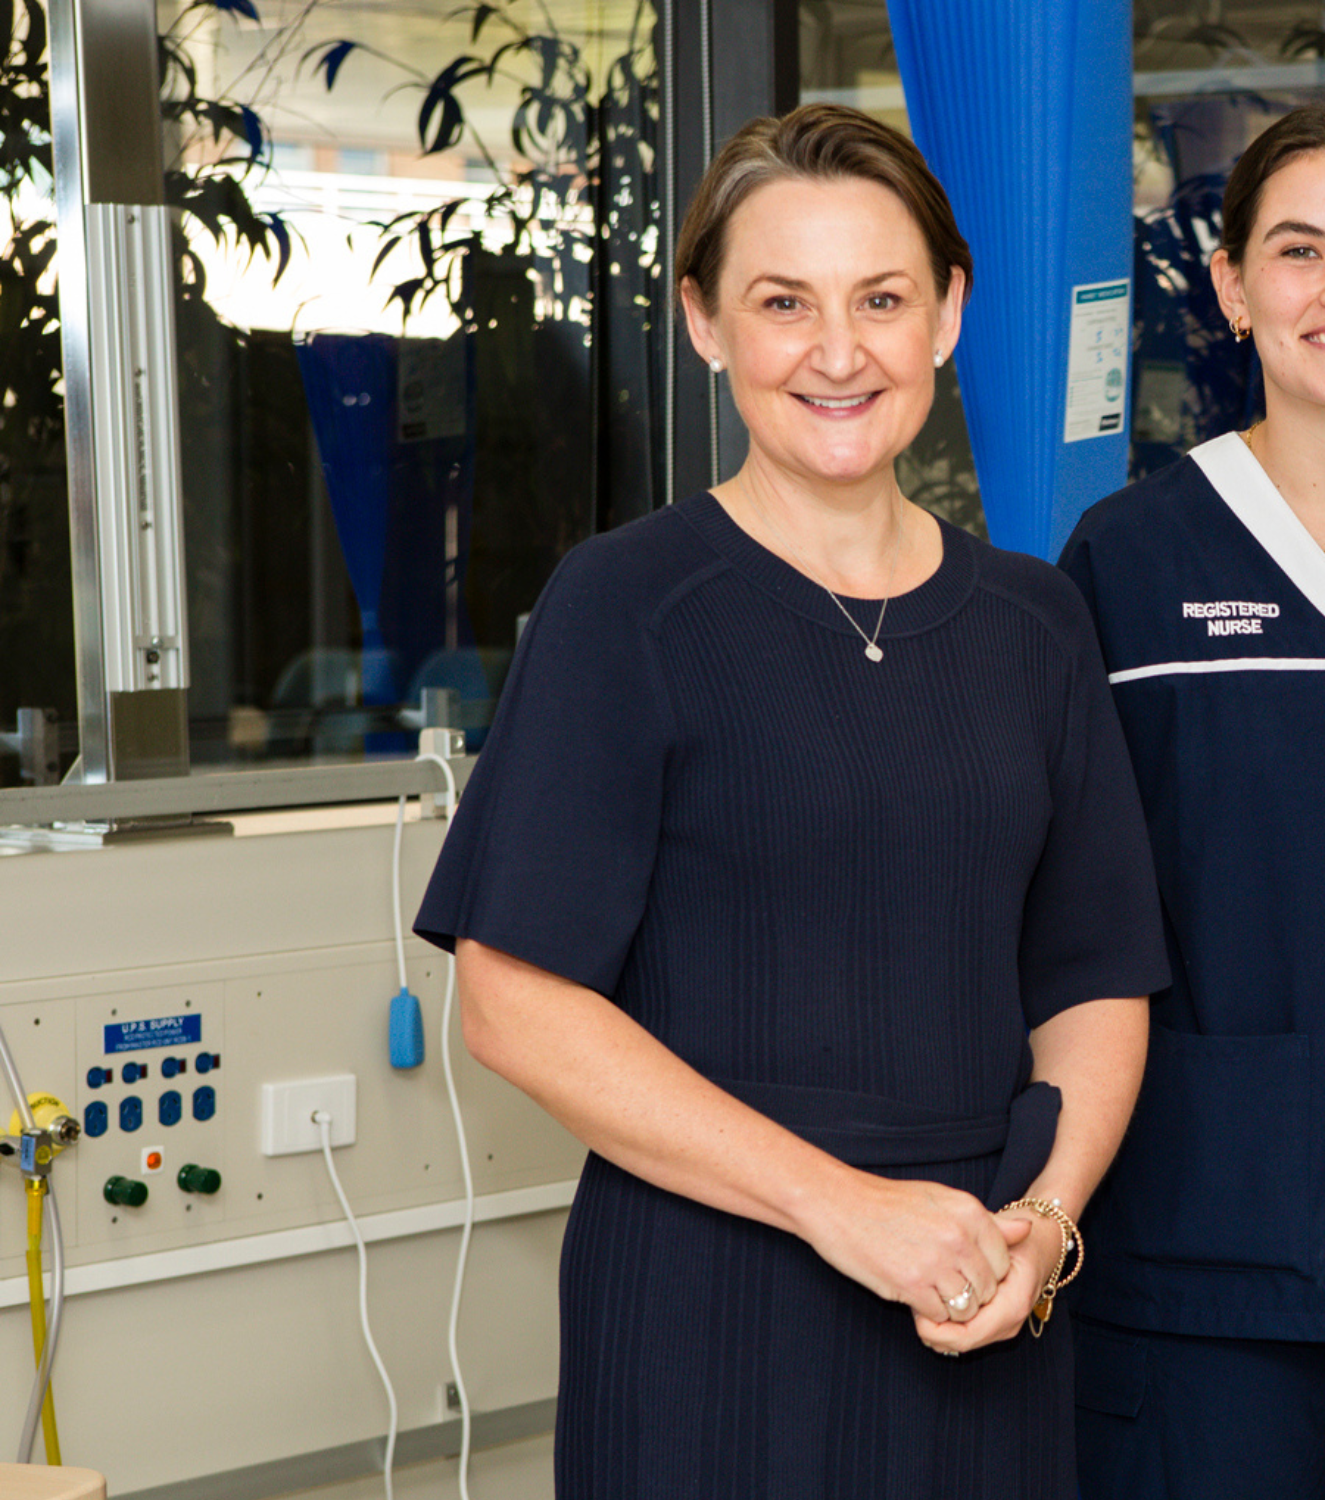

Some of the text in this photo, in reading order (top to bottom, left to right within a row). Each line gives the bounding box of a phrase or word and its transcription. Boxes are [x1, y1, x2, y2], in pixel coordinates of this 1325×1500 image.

[1182, 601, 1280, 618] REGISTERED
[1207, 618, 1264, 637] NURSE
[149, 1017, 184, 1030] SUPPLY
